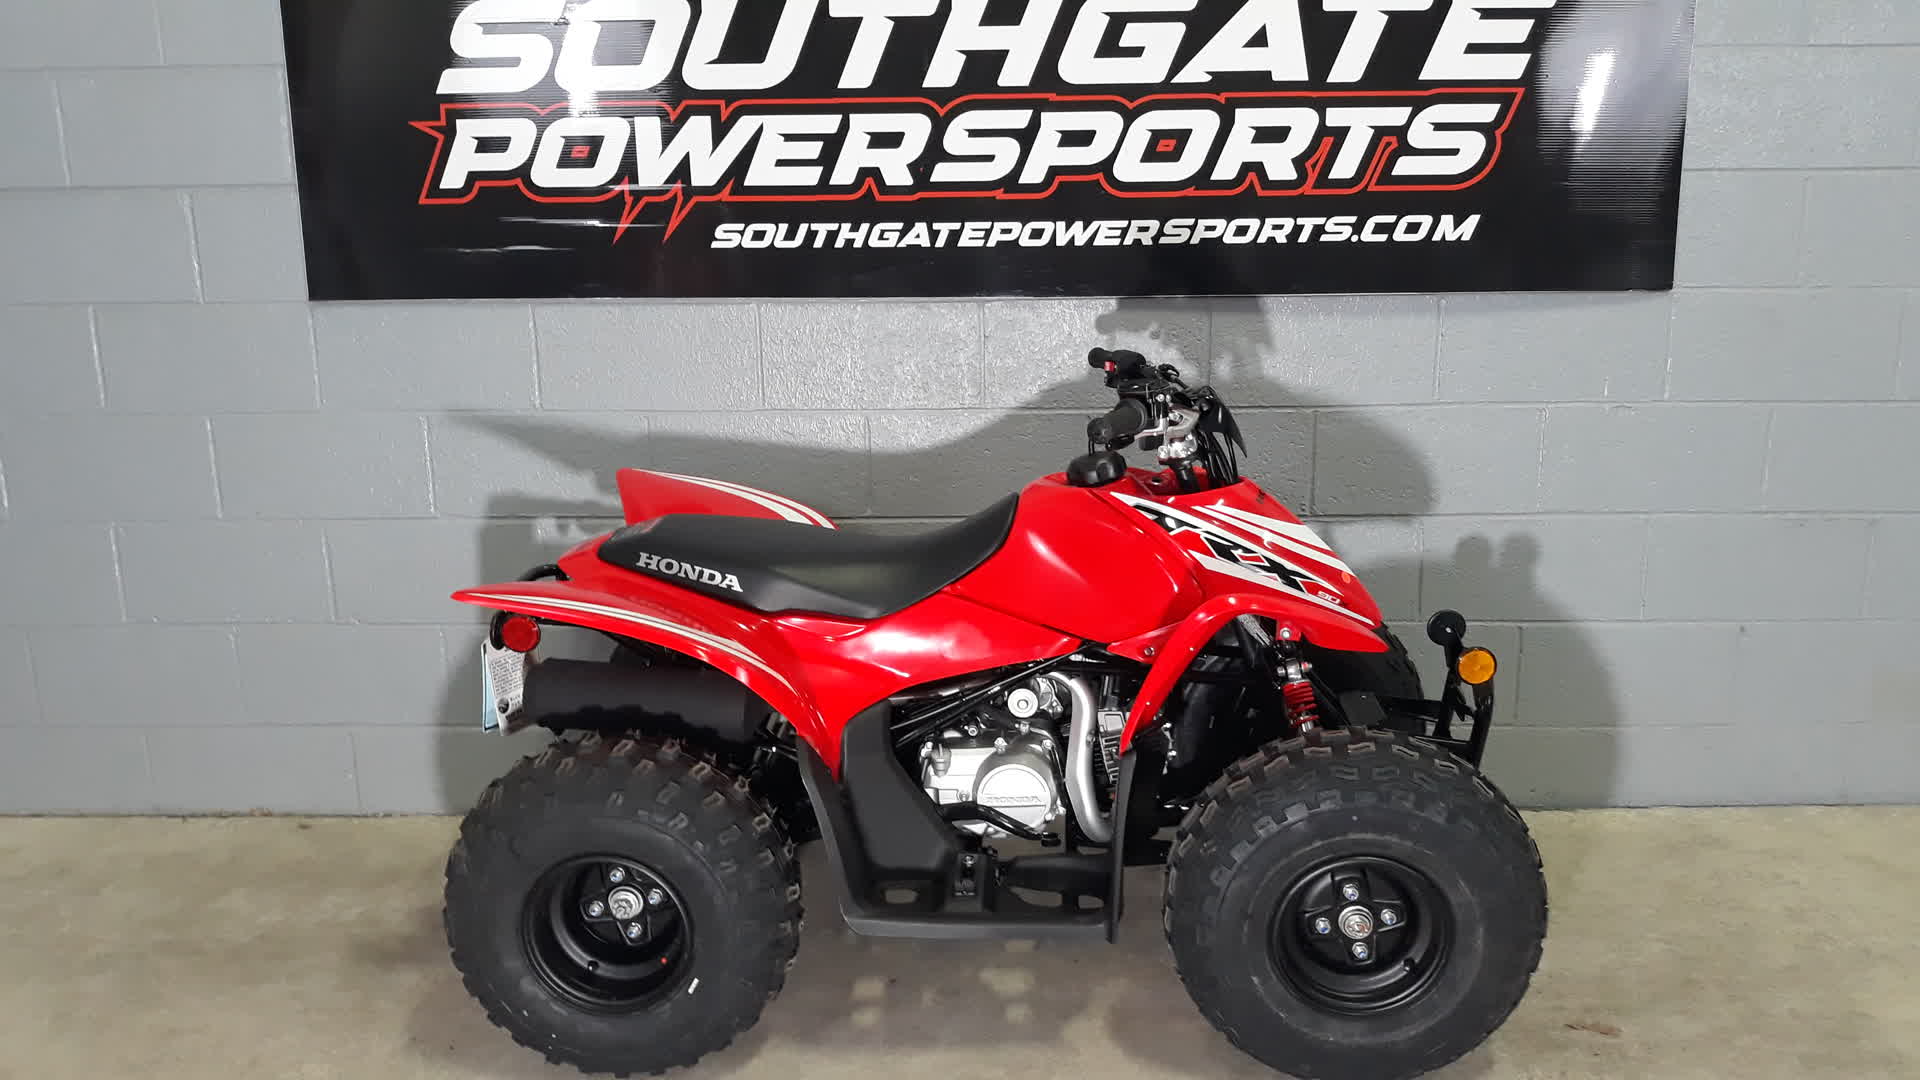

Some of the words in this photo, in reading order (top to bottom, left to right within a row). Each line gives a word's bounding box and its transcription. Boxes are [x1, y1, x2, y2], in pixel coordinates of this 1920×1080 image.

[436, 0, 1556, 94] SOUTHGATE
[440, 103, 1501, 189] POWERSPORTS
[711, 214, 1481, 249] SOUTHGATEPOWERSPORTS.COM
[635, 551, 744, 593] HONDA
